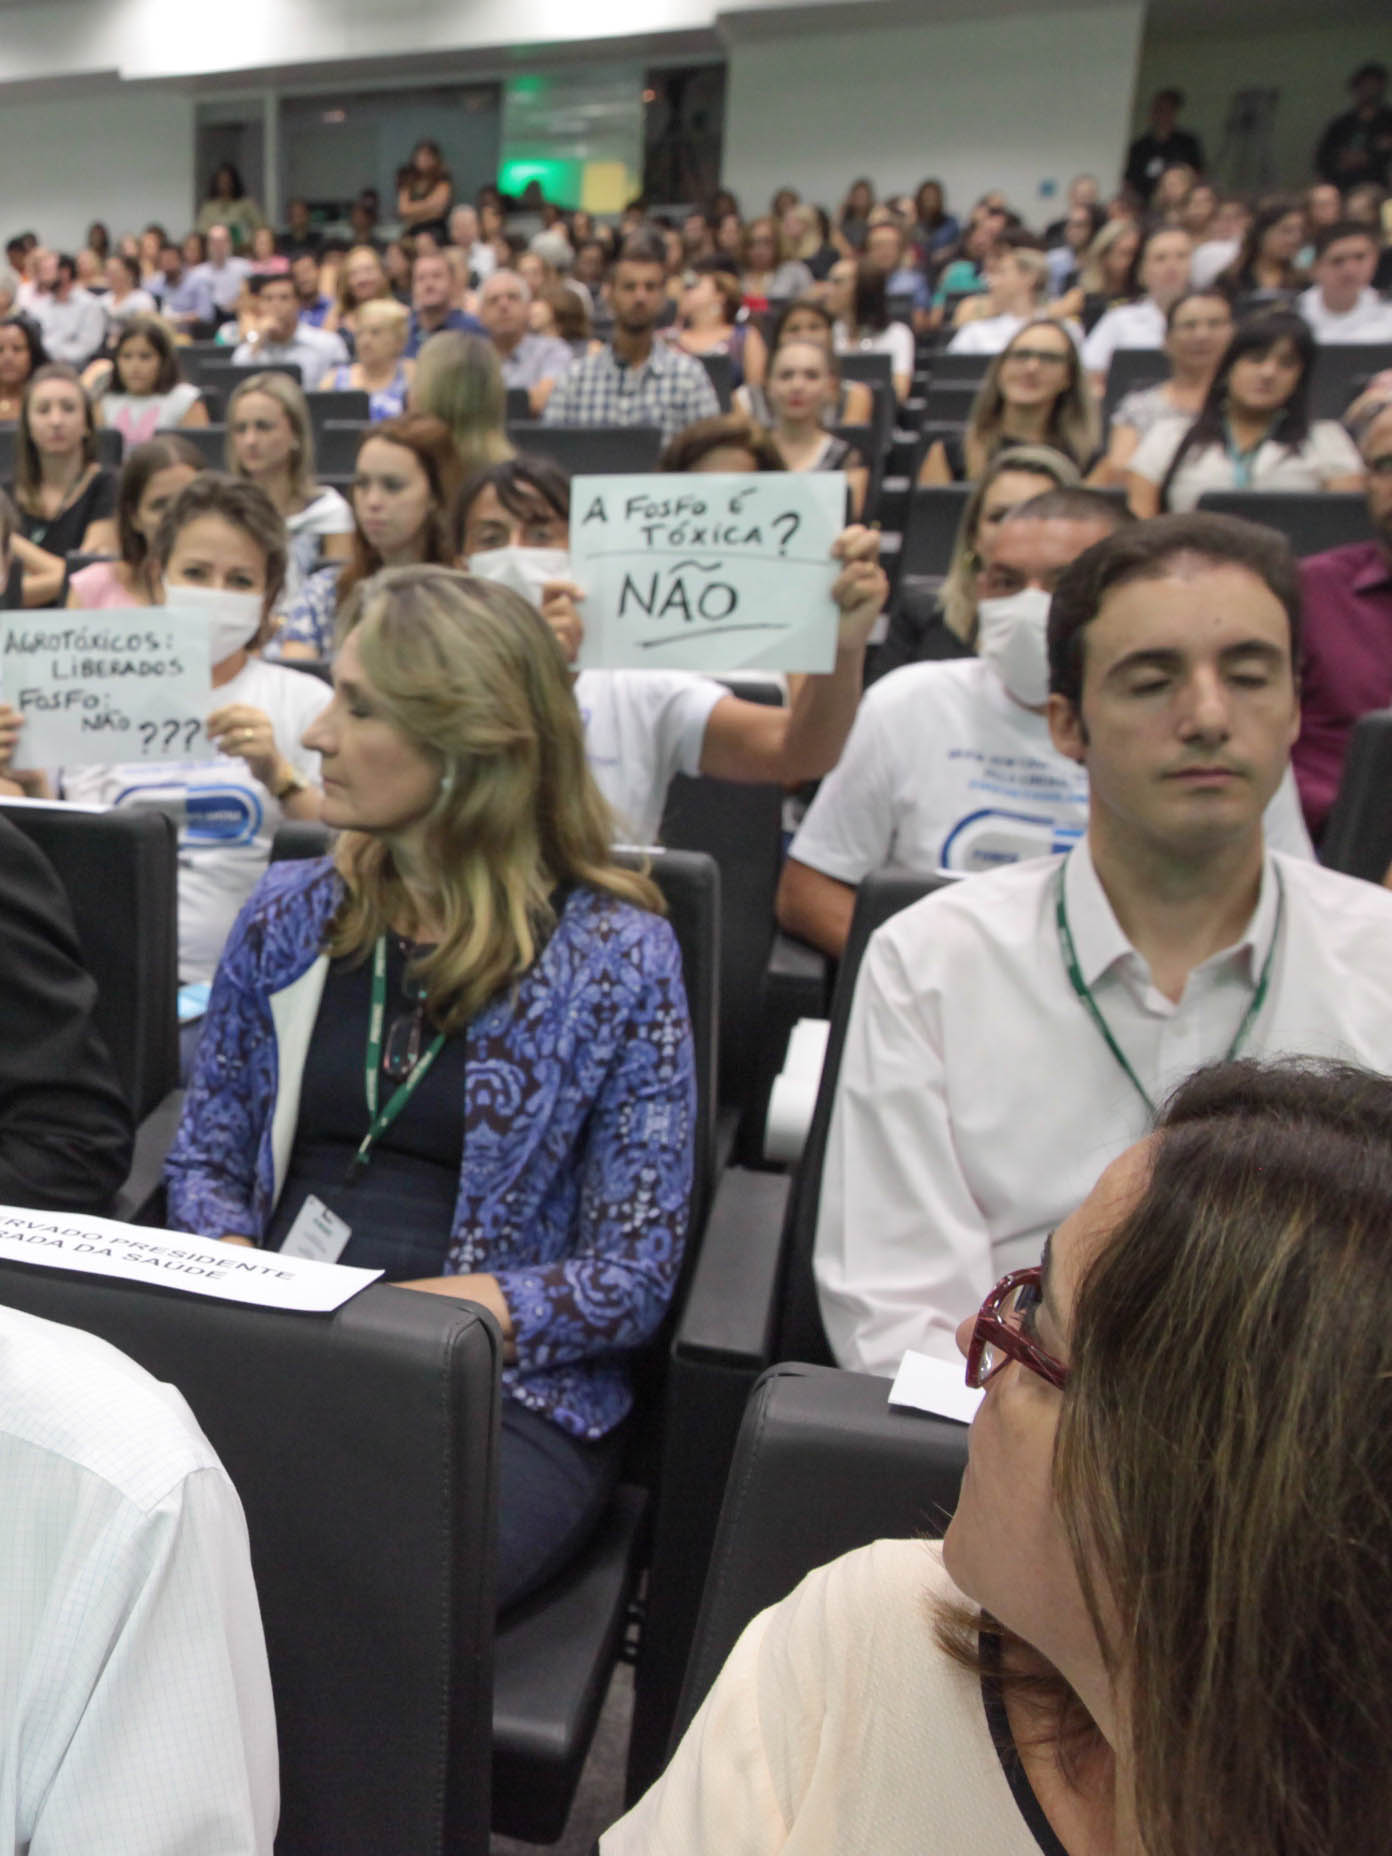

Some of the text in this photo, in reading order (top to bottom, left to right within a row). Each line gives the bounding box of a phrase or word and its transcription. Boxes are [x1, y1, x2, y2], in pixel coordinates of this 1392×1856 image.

[581, 486, 758, 526] A FOSFO É
[617, 560, 739, 623] NÃO
[138, 718, 202, 755] ???
[73, 1243, 113, 1257] DA
[109, 1237, 297, 1281] PRESIDENTE
